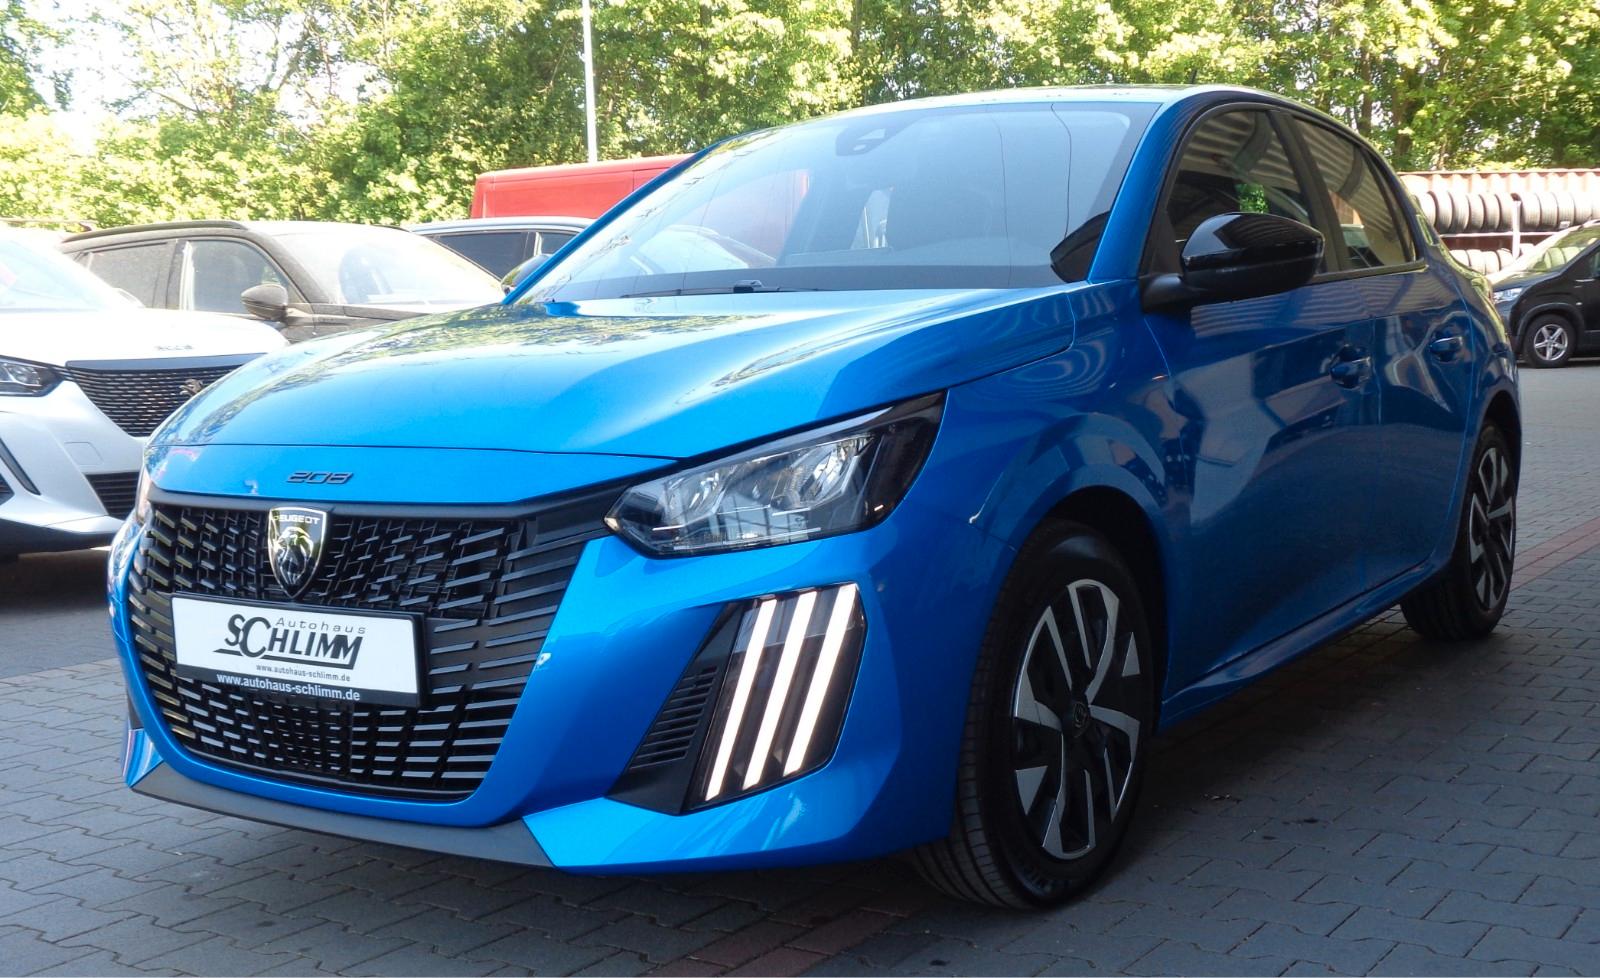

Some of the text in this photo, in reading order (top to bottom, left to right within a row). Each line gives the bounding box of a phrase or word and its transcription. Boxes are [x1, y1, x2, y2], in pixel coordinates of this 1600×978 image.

[286, 471, 354, 485] 208
[275, 617, 367, 635] Autohaus
[224, 613, 364, 661] SCHLIMM
[256, 664, 351, 682] www.autohaus-schlimm.de
[216, 673, 361, 701] www.autohaus-schlimm.de
